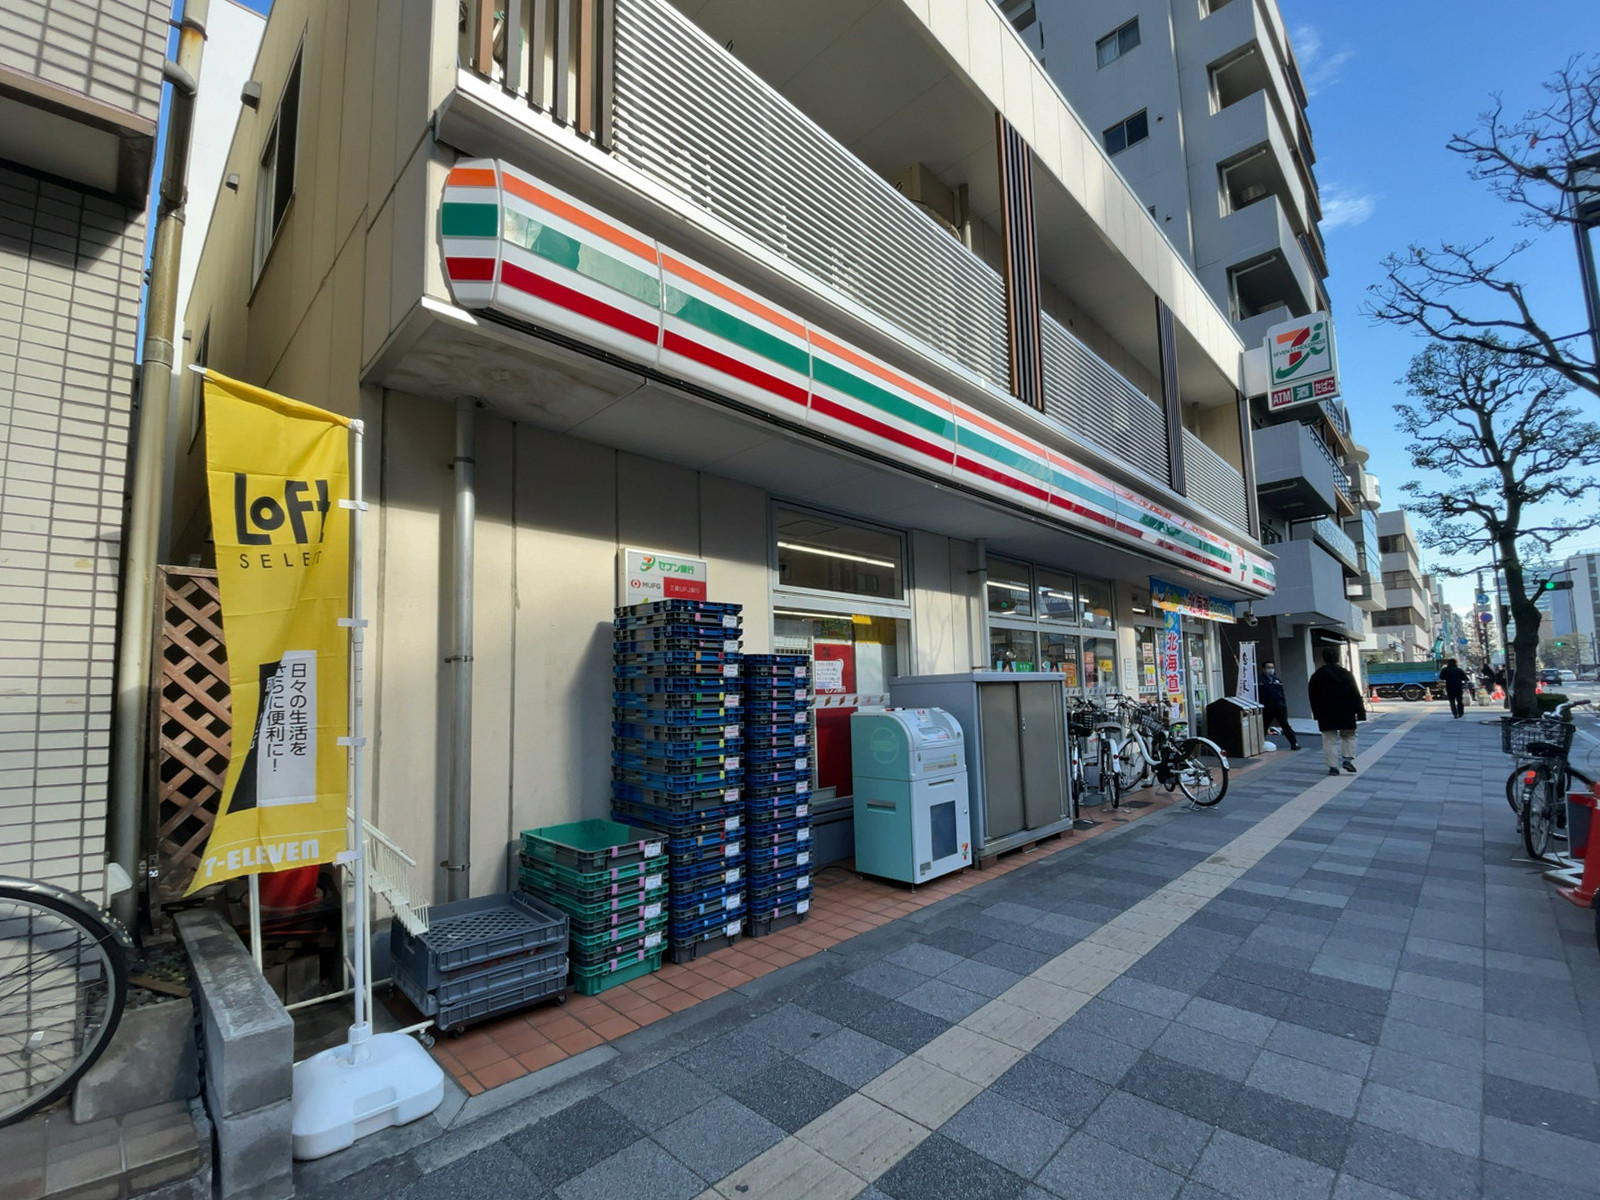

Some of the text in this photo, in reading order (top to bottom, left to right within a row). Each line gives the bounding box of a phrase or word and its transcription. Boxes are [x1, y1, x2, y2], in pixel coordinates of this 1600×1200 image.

[1296, 385, 1309, 399] 酒
[1315, 379, 1334, 395] たばこ
[1273, 391, 1291, 405] ATM
[658, 560, 695, 575] セブン銀行
[642, 581, 661, 590] MUFG
[1166, 631, 1180, 693] 北海道
[289, 663, 308, 756] 日々の生活を
